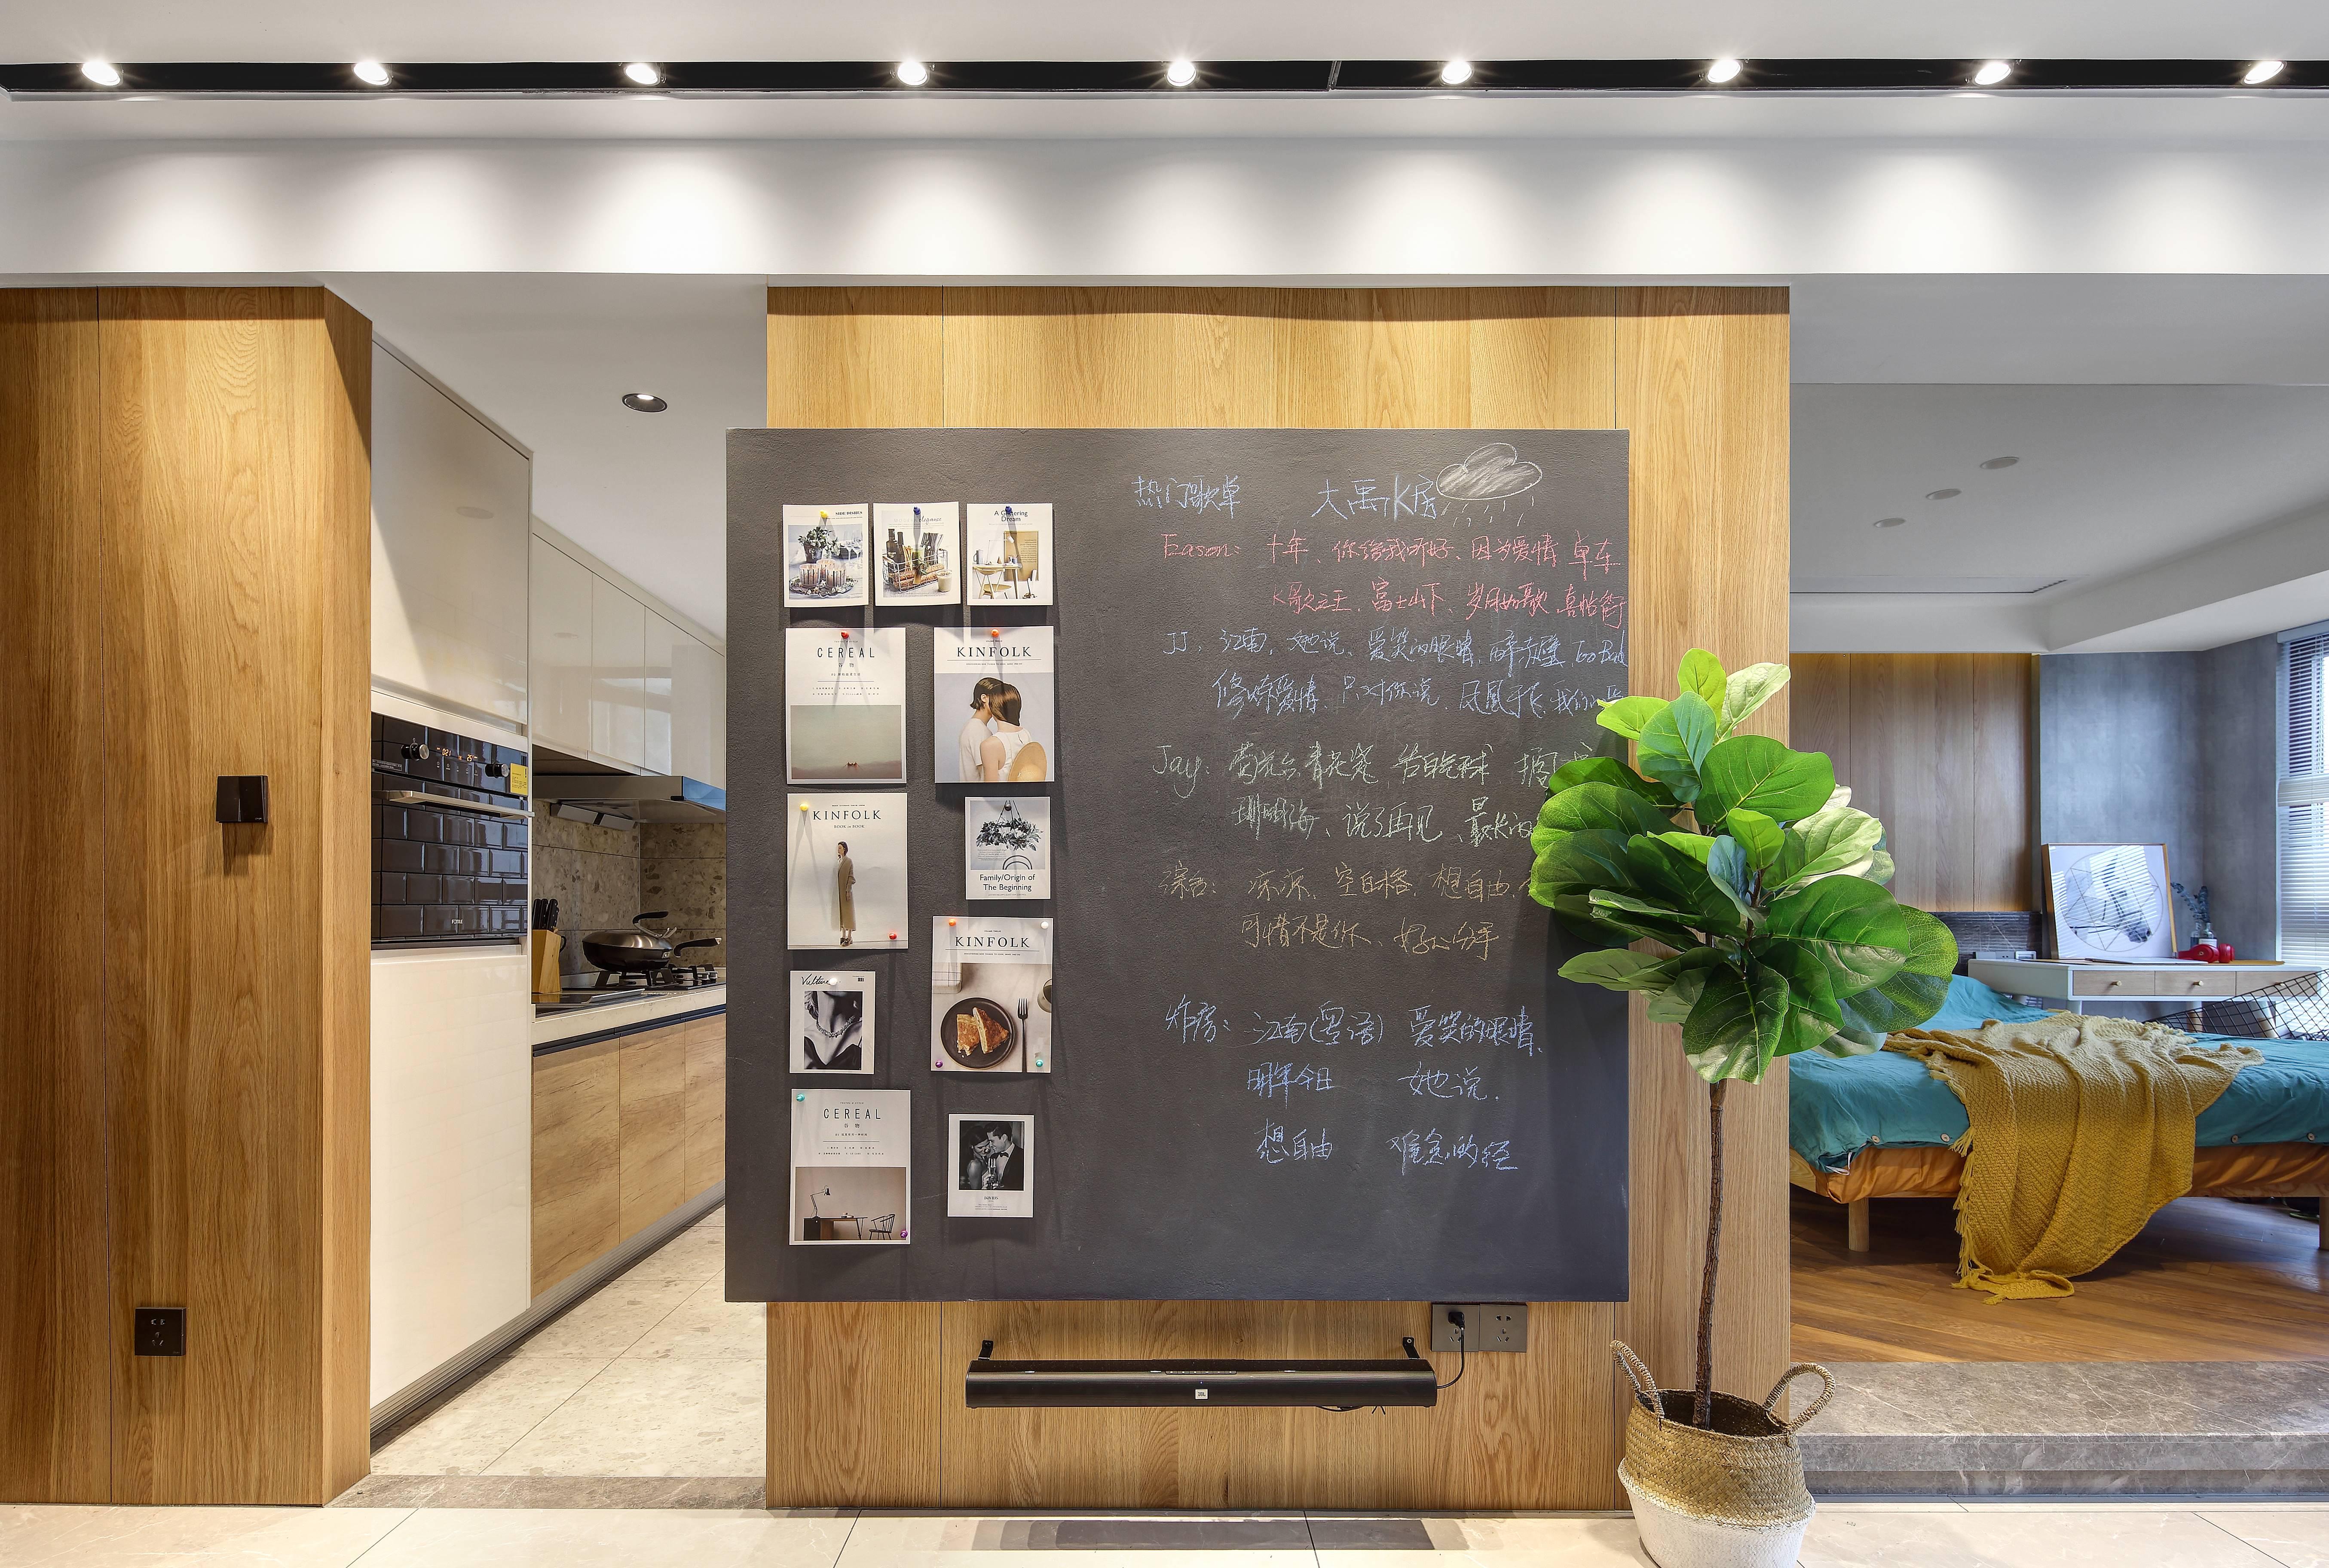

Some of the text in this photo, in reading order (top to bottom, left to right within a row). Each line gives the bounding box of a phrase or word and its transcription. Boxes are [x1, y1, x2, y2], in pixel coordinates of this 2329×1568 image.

[817, 647, 875, 658] CEREAL
[957, 646, 1031, 657] KINFOLK
[813, 810, 881, 820] KINFOLK
[980, 874, 1025, 882] Family/Origin
[955, 937, 1030, 948] KINFOLK
[823, 1109, 881, 1119] CEREAL
